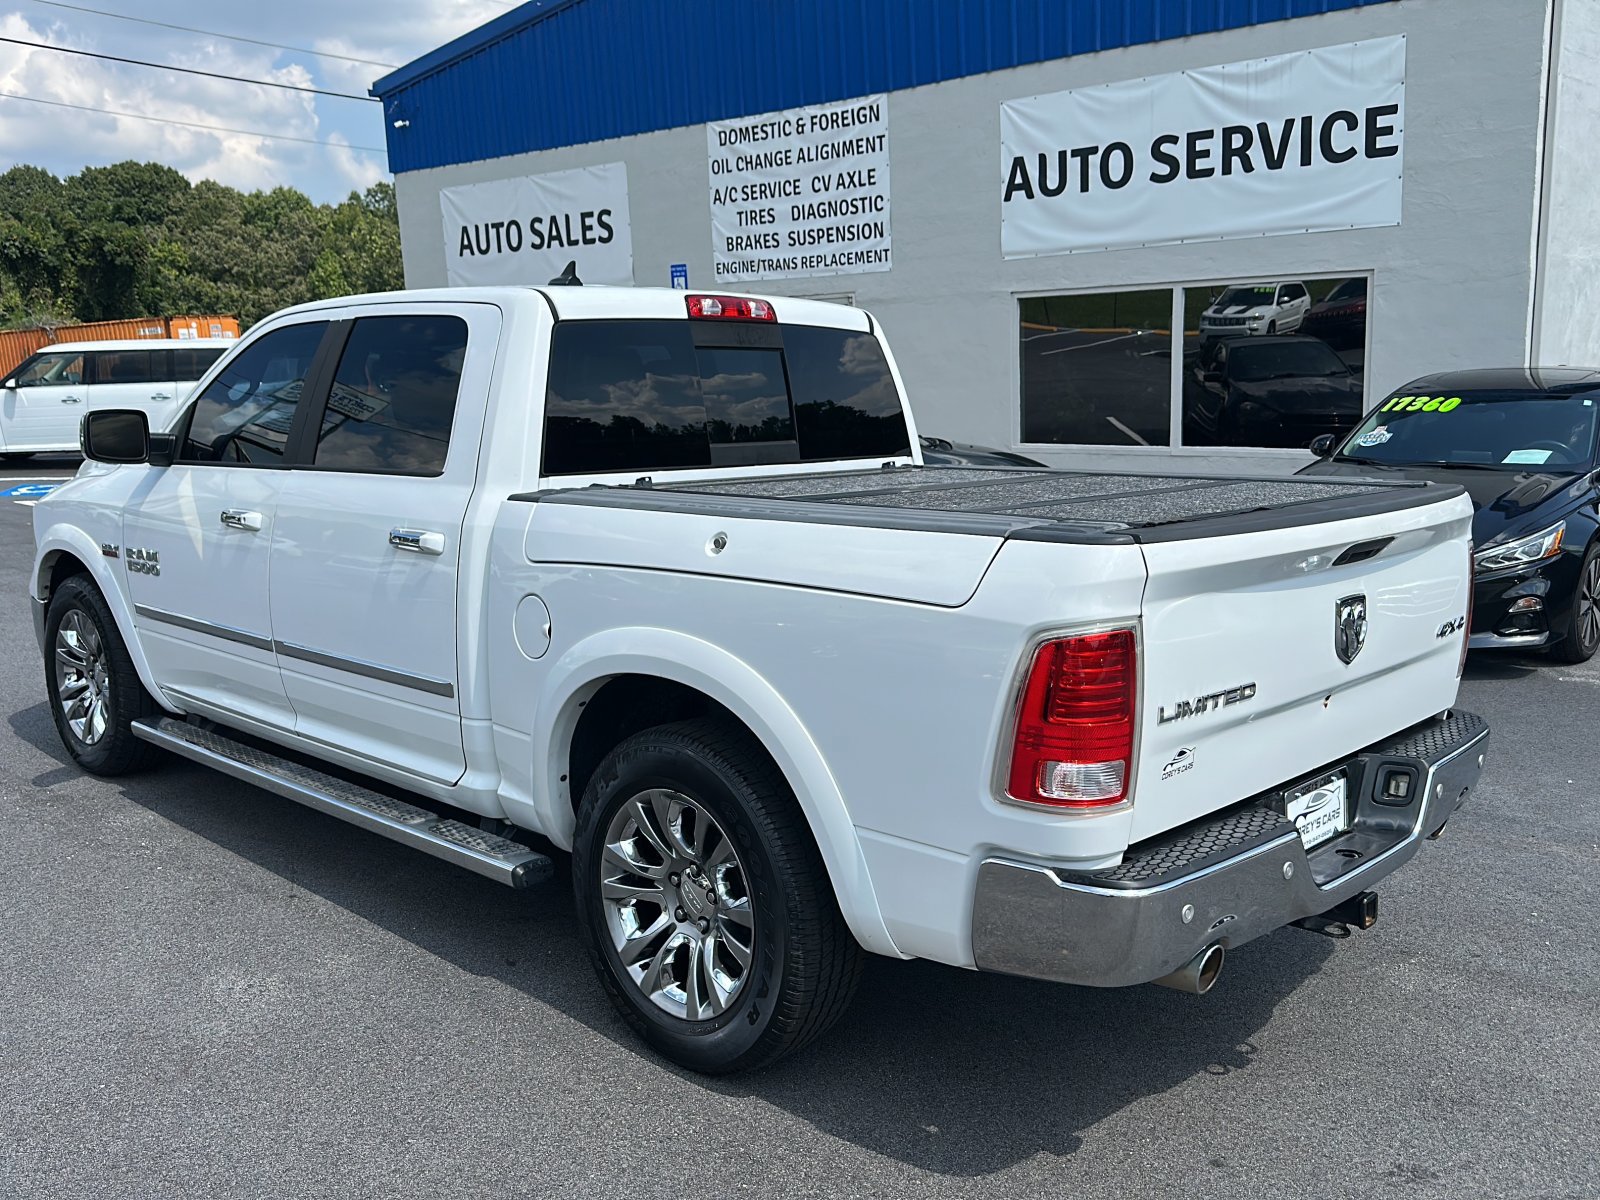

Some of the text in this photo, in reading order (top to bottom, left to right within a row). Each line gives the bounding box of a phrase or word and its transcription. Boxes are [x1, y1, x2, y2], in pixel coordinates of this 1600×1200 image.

[718, 104, 880, 146] DOMESTIC & FOREIGN
[711, 134, 886, 175] OIL CHANGE ALIGNMENT
[1003, 103, 1399, 202] AUTO SERVICE
[713, 168, 877, 206] A/C SERVICE CV AXLE
[737, 195, 884, 227] TIRES DIAGNOSTIC
[459, 209, 614, 257] AUTO SALES
[726, 221, 884, 252] BRAKES SUSPENSION
[716, 248, 890, 275] ENGINE/TRANS REPLACEMENT
[126, 547, 159, 562] RAM
[127, 560, 160, 577] 1500
[1157, 681, 1257, 727] LIMITED
[1322, 808, 1341, 825] CARS
